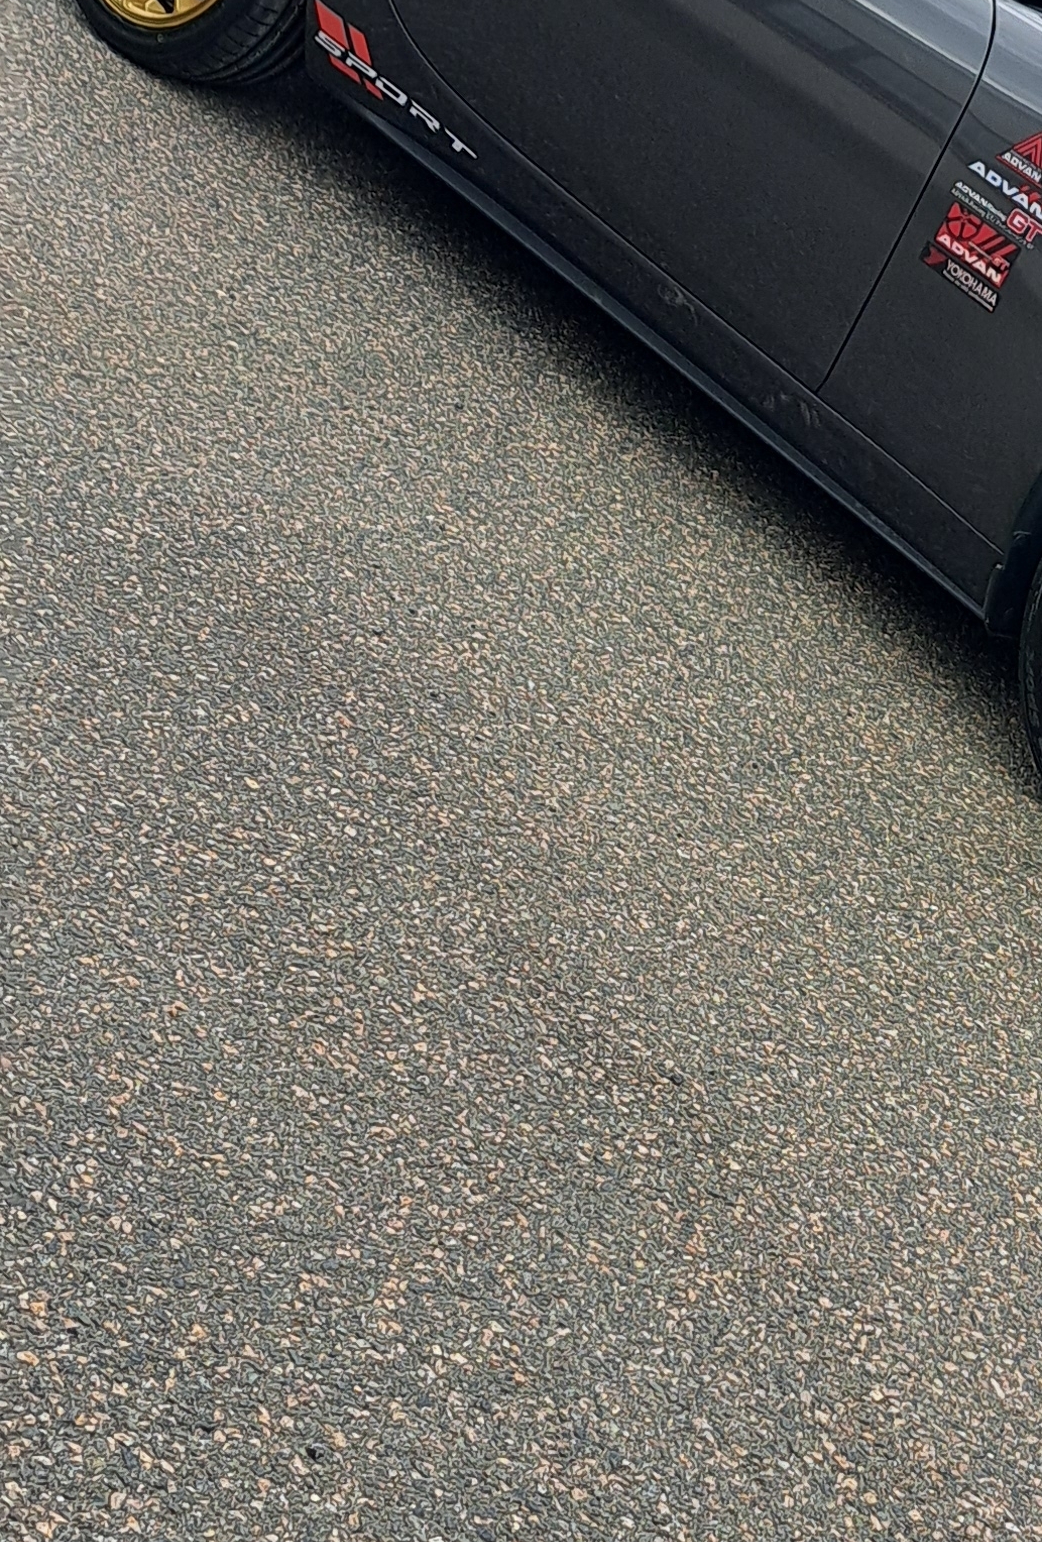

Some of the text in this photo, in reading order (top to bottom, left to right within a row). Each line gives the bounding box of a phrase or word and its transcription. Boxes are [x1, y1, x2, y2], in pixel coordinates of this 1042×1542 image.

[314, 29, 478, 159] SPORT
[1001, 152, 1042, 183] ADVAN
[936, 233, 1002, 283] ADVAN
[945, 258, 998, 307] YOKOHAMA
